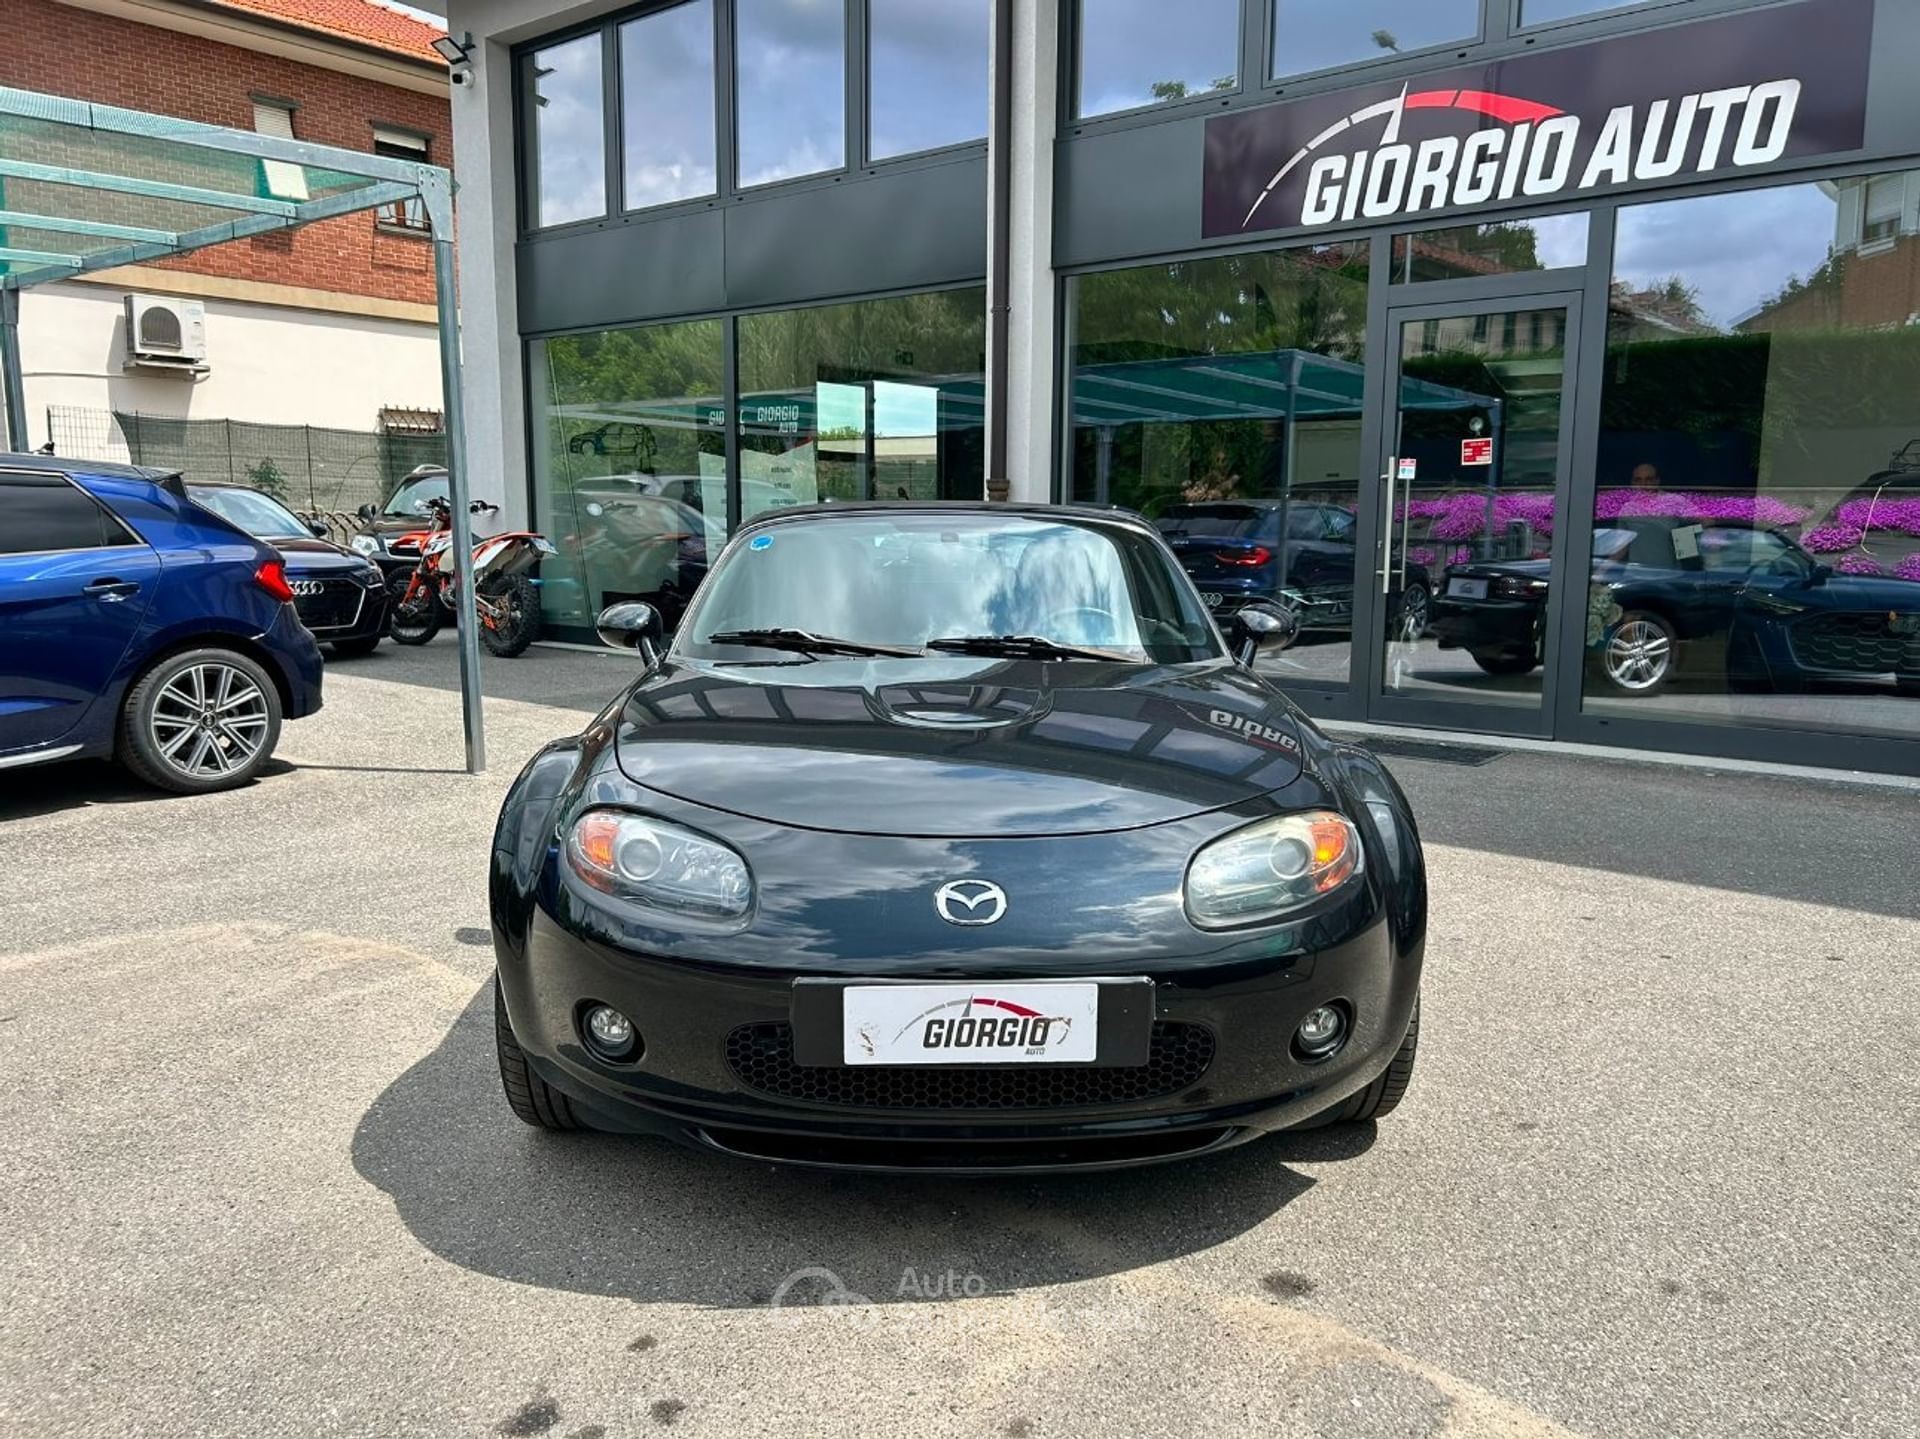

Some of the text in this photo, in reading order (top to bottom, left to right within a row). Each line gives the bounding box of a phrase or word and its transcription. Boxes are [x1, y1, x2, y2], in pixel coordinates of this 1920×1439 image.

[1300, 78, 1801, 227] GIORGIO AUTO
[757, 404, 799, 422] GIORGIO
[923, 1017, 1050, 1048] GIORGIO
[1025, 1047, 1046, 1056] AUTO
